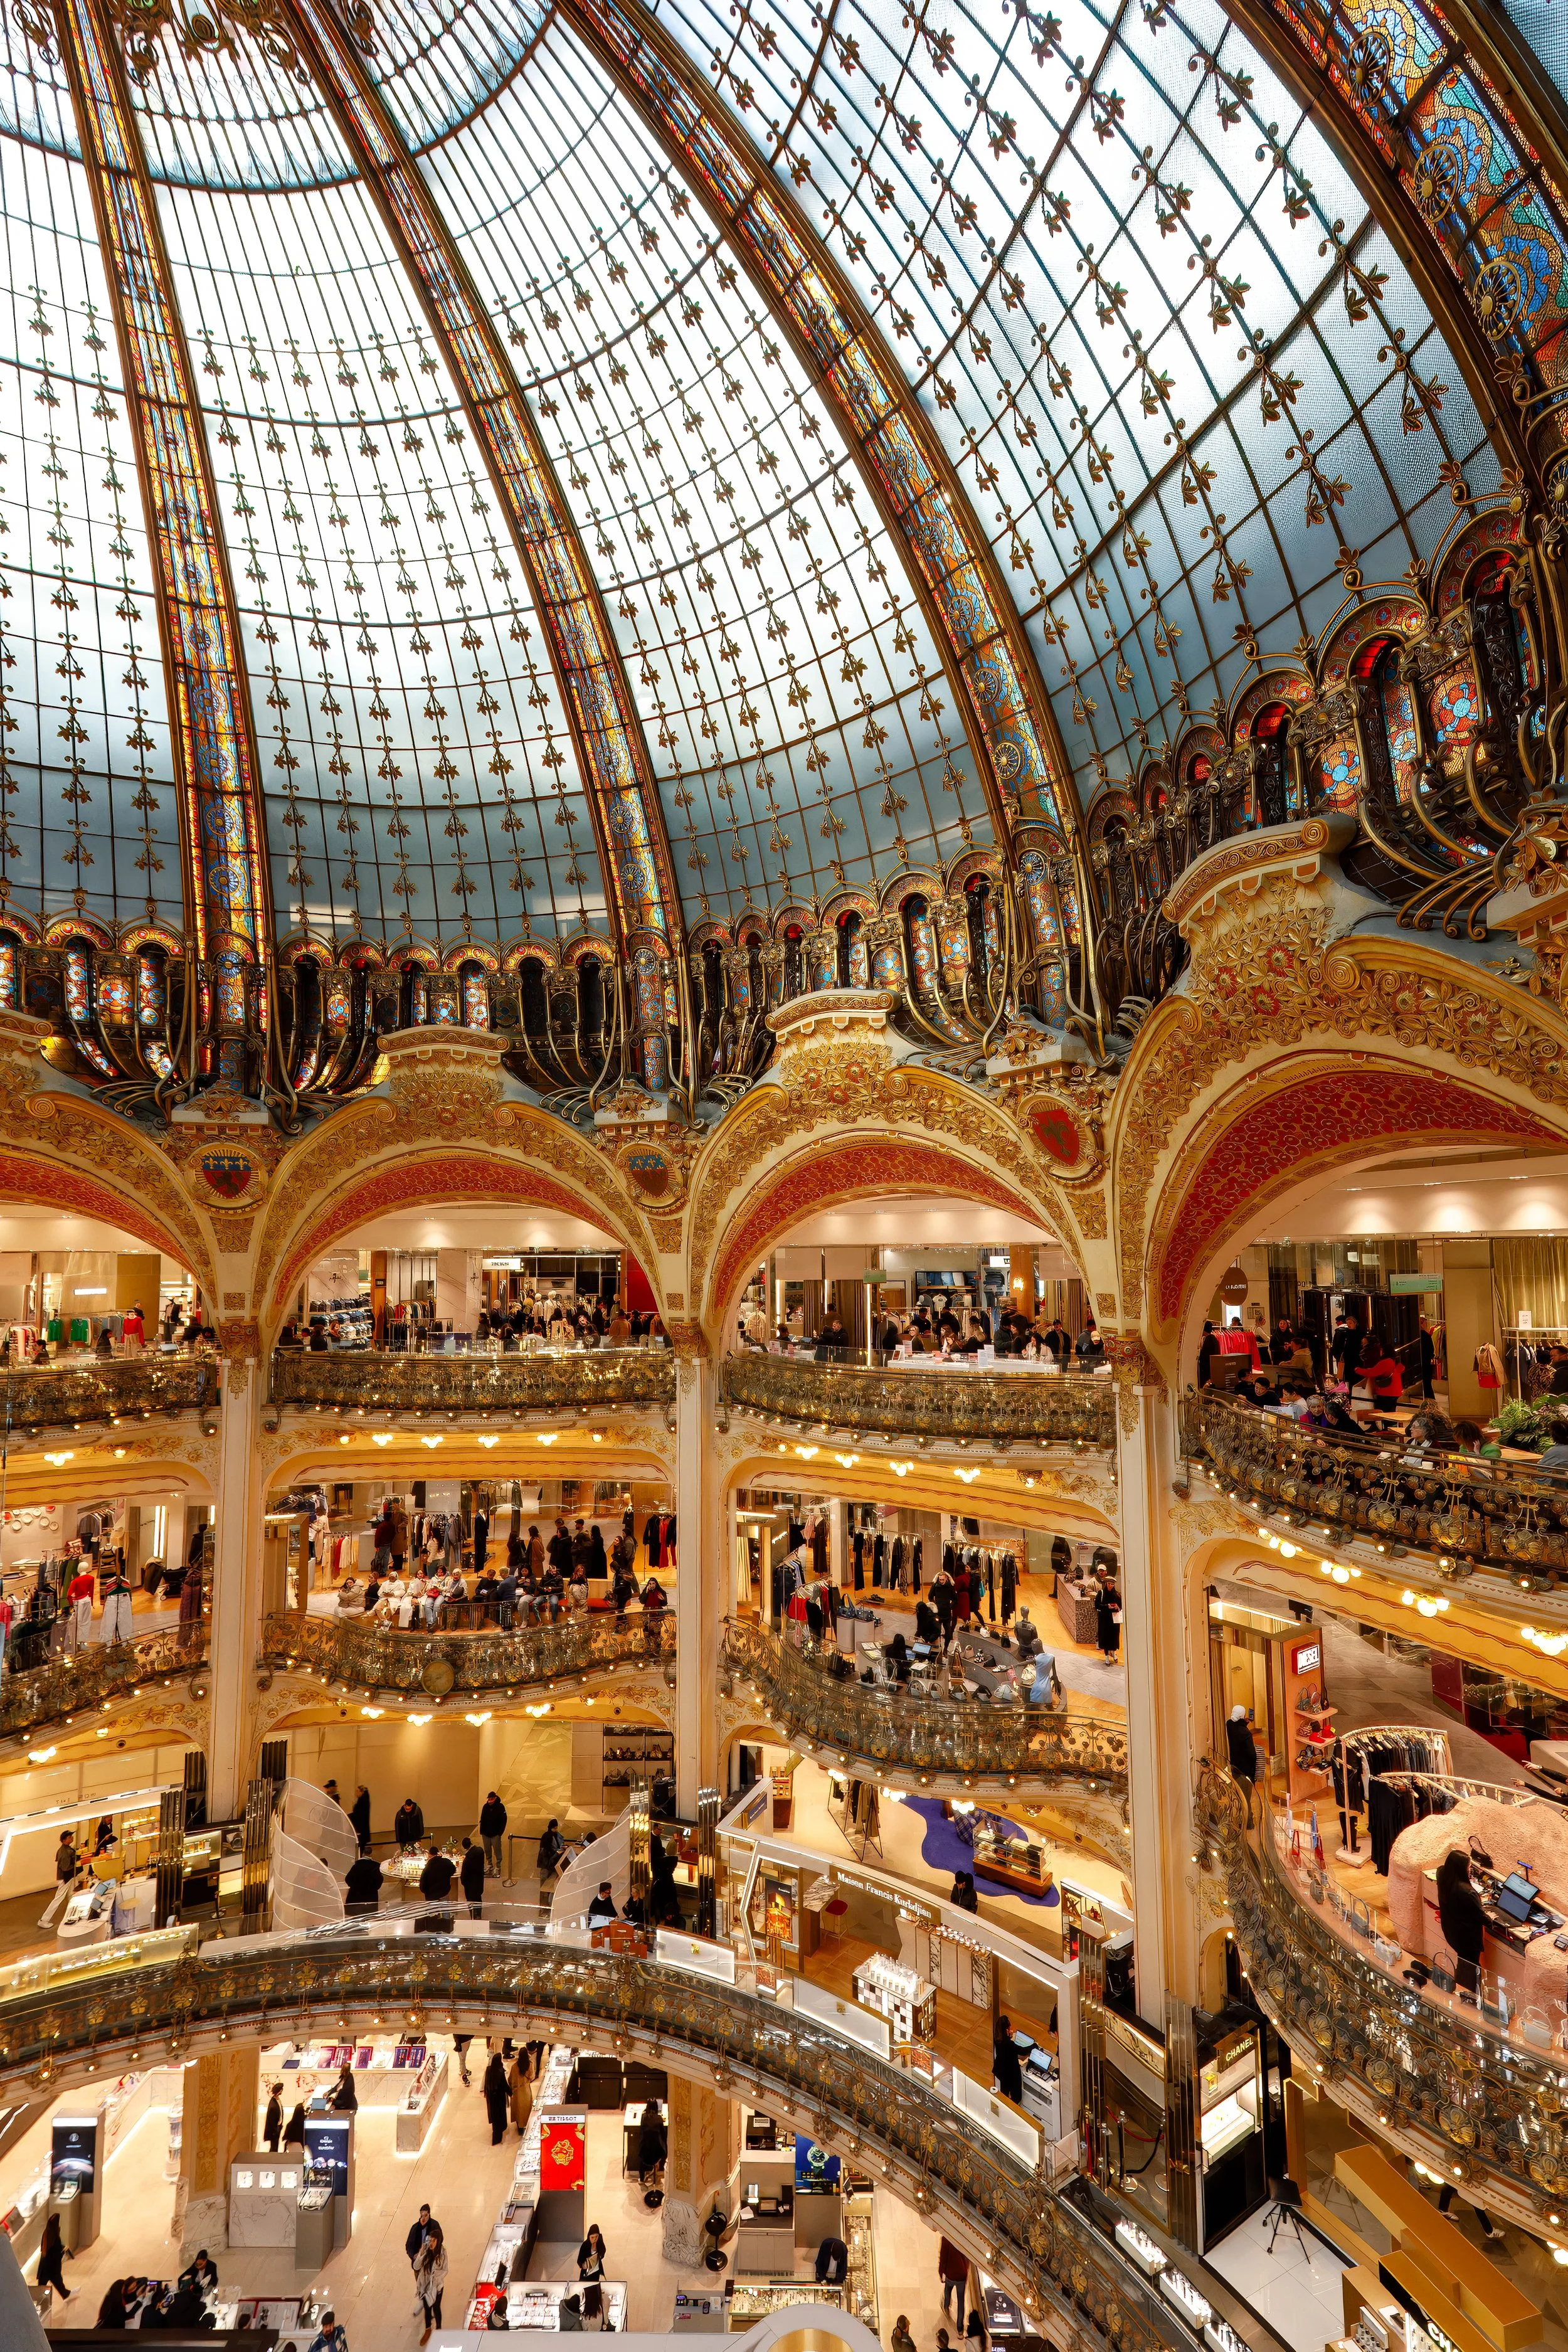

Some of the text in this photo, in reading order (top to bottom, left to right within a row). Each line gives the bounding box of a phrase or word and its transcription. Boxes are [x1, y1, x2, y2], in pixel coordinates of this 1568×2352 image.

[837, 1872, 931, 1919] Maison Francis Kurkdjian
[1226, 2037, 1254, 2062] CHANEL
